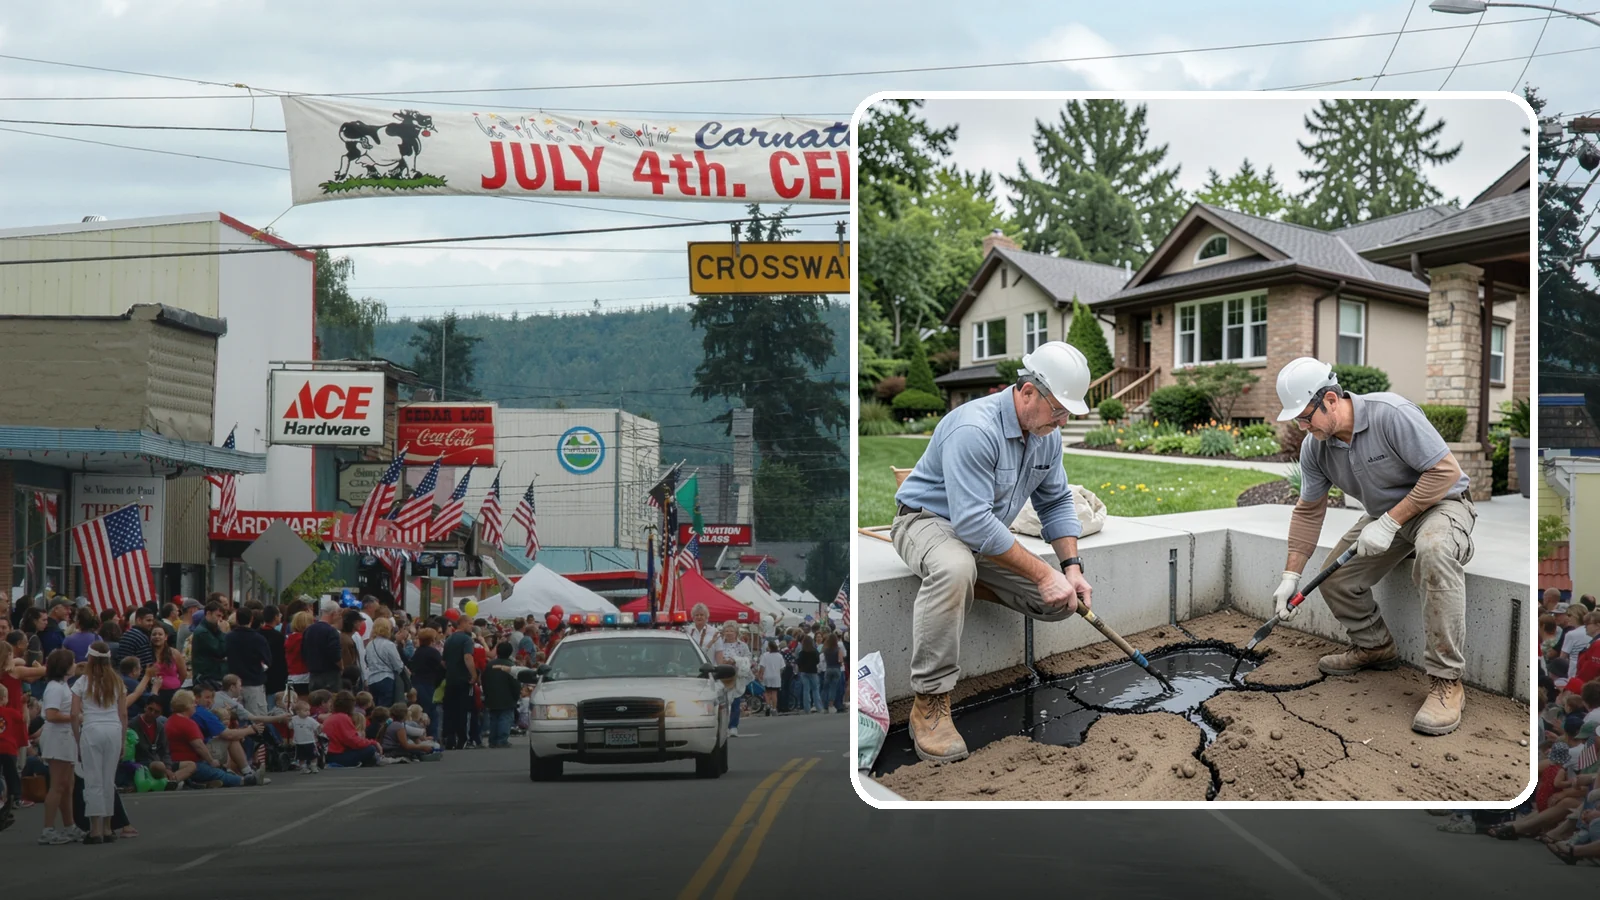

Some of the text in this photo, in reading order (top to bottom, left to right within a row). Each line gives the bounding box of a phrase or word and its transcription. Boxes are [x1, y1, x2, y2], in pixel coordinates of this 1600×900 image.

[695, 121, 850, 149] Carnat
[481, 140, 605, 192] JULY
[631, 150, 747, 198] 4th.
[696, 254, 850, 280] CROSSWA
[283, 380, 373, 420] ACE
[405, 409, 485, 422] CEDAR LOG
[283, 421, 371, 436] Hardware
[416, 428, 477, 447] Coca-Cola
[353, 467, 385, 480] Simpl
[83, 484, 155, 496] St. Vincent de Paul
[688, 526, 741, 535] CRNATION
[699, 535, 730, 543] GLASS
